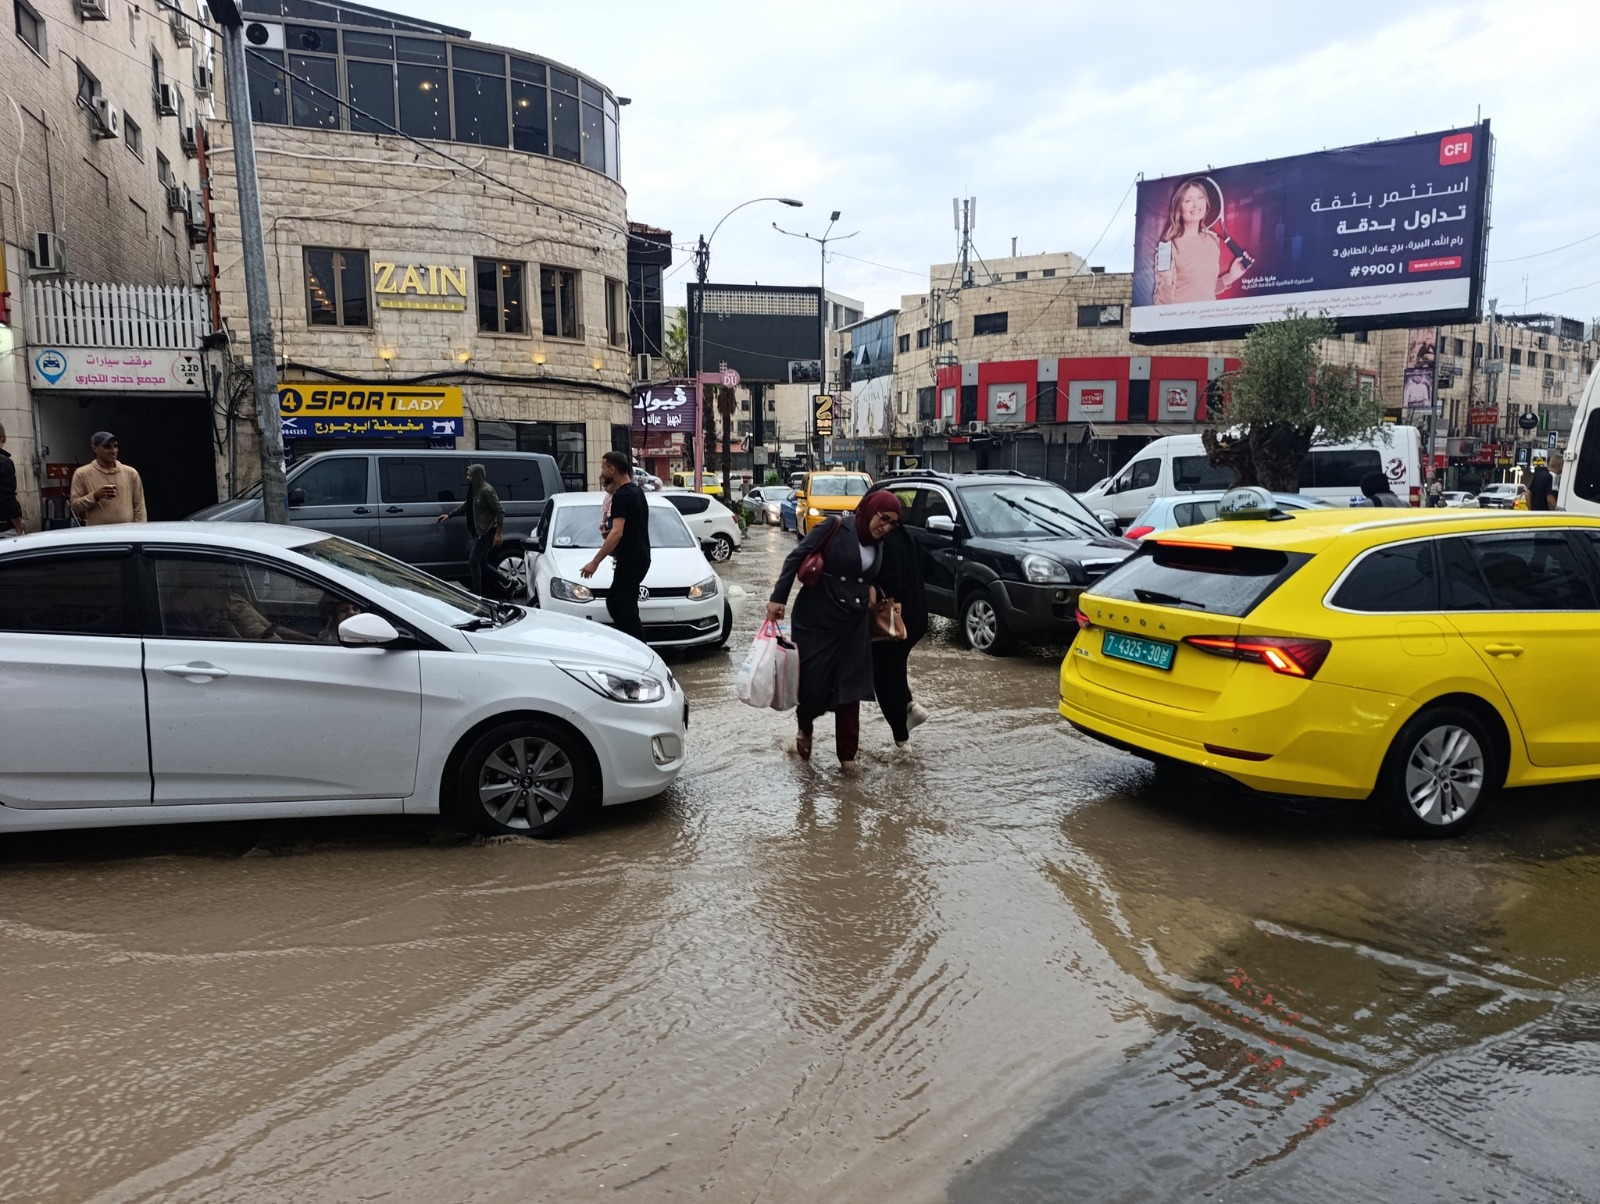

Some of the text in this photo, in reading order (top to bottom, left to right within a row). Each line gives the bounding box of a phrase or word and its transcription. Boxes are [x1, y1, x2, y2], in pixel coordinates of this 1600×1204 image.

[1444, 142, 1468, 157] CFI
[1310, 176, 1469, 213] استثمر بثقة
[1336, 205, 1467, 235] تداول بدقة
[1390, 243, 1404, 254] برج
[1450, 235, 1464, 248] رام
[1332, 249, 1339, 257] 3
[1340, 245, 1367, 258] الطابق
[1350, 258, 1456, 278] #9900 www.cfi.trade
[374, 261, 467, 297] ZAIN
[86, 354, 152, 368] موقف سيارات
[180, 364, 199, 372] 220
[75, 374, 166, 387] مجمع حداد التجاري
[723, 376, 737, 386] DU
[282, 390, 445, 411] 4 SPORT LADY
[373, 419, 424, 434] مخيطة
[666, 413, 682, 427] تجهيز
